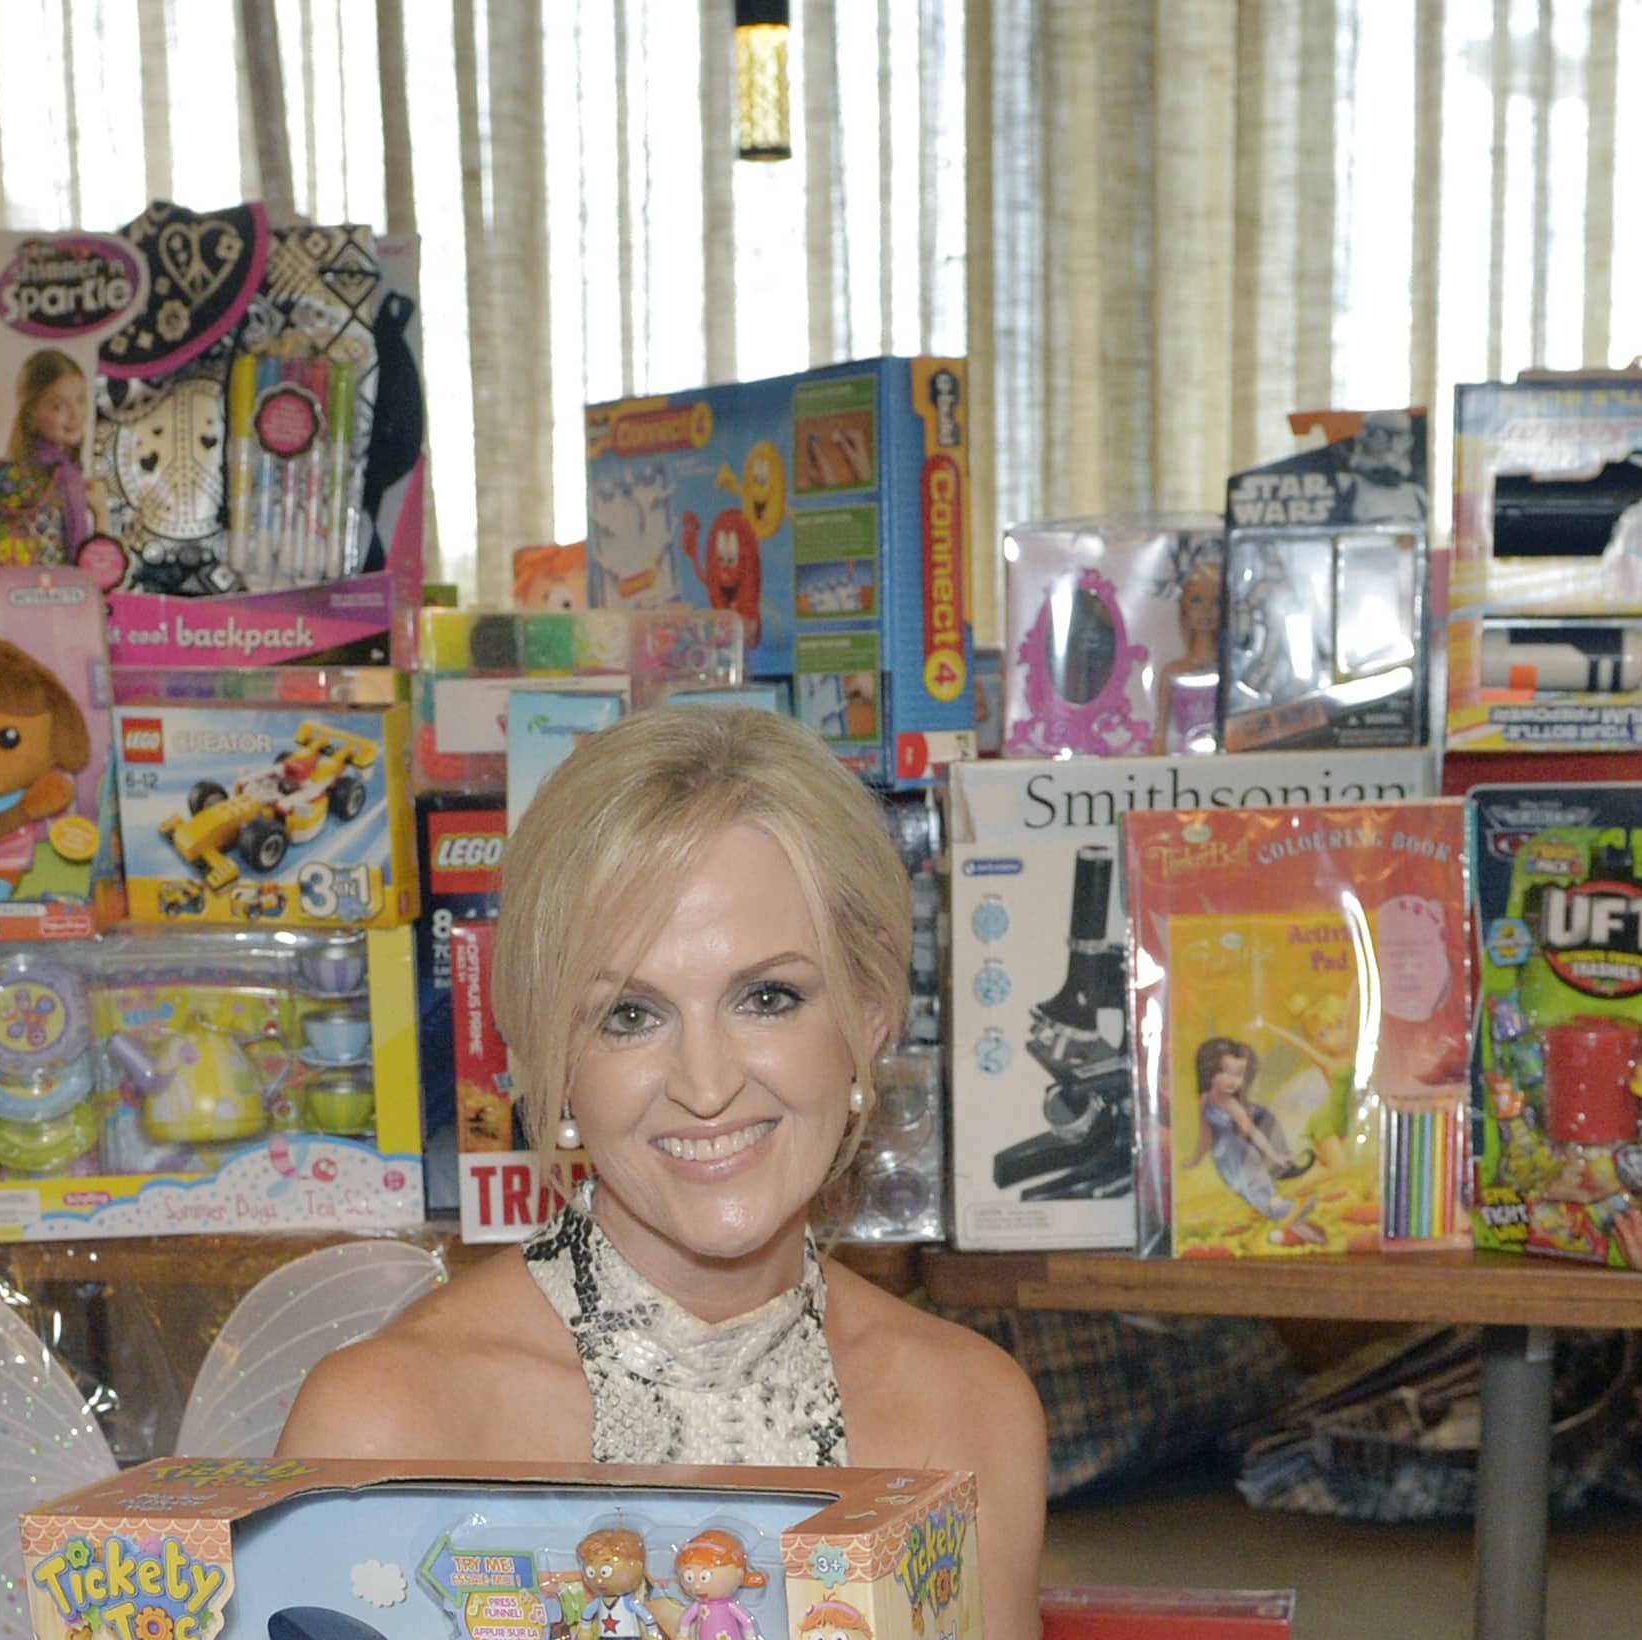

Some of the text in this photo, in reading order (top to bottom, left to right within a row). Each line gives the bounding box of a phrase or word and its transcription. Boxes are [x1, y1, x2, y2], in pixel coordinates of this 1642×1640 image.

[1236, 475, 1336, 500] STAR
[1232, 501, 1336, 526] WARS
[176, 617, 314, 656] backpack
[934, 661, 959, 686] 4
[436, 835, 504, 869] LEGO
[1392, 831, 1452, 863] BOOK
[454, 1557, 515, 1573] TRY ME!
[815, 1554, 843, 1575] 3+
[897, 1513, 966, 1600] Tickety
[31, 1534, 223, 1618] Tickety
[484, 1607, 524, 1619] FUNNEL!
[488, 1597, 517, 1608] PRESS
[473, 1627, 538, 1638] APPUIE SUR LA
